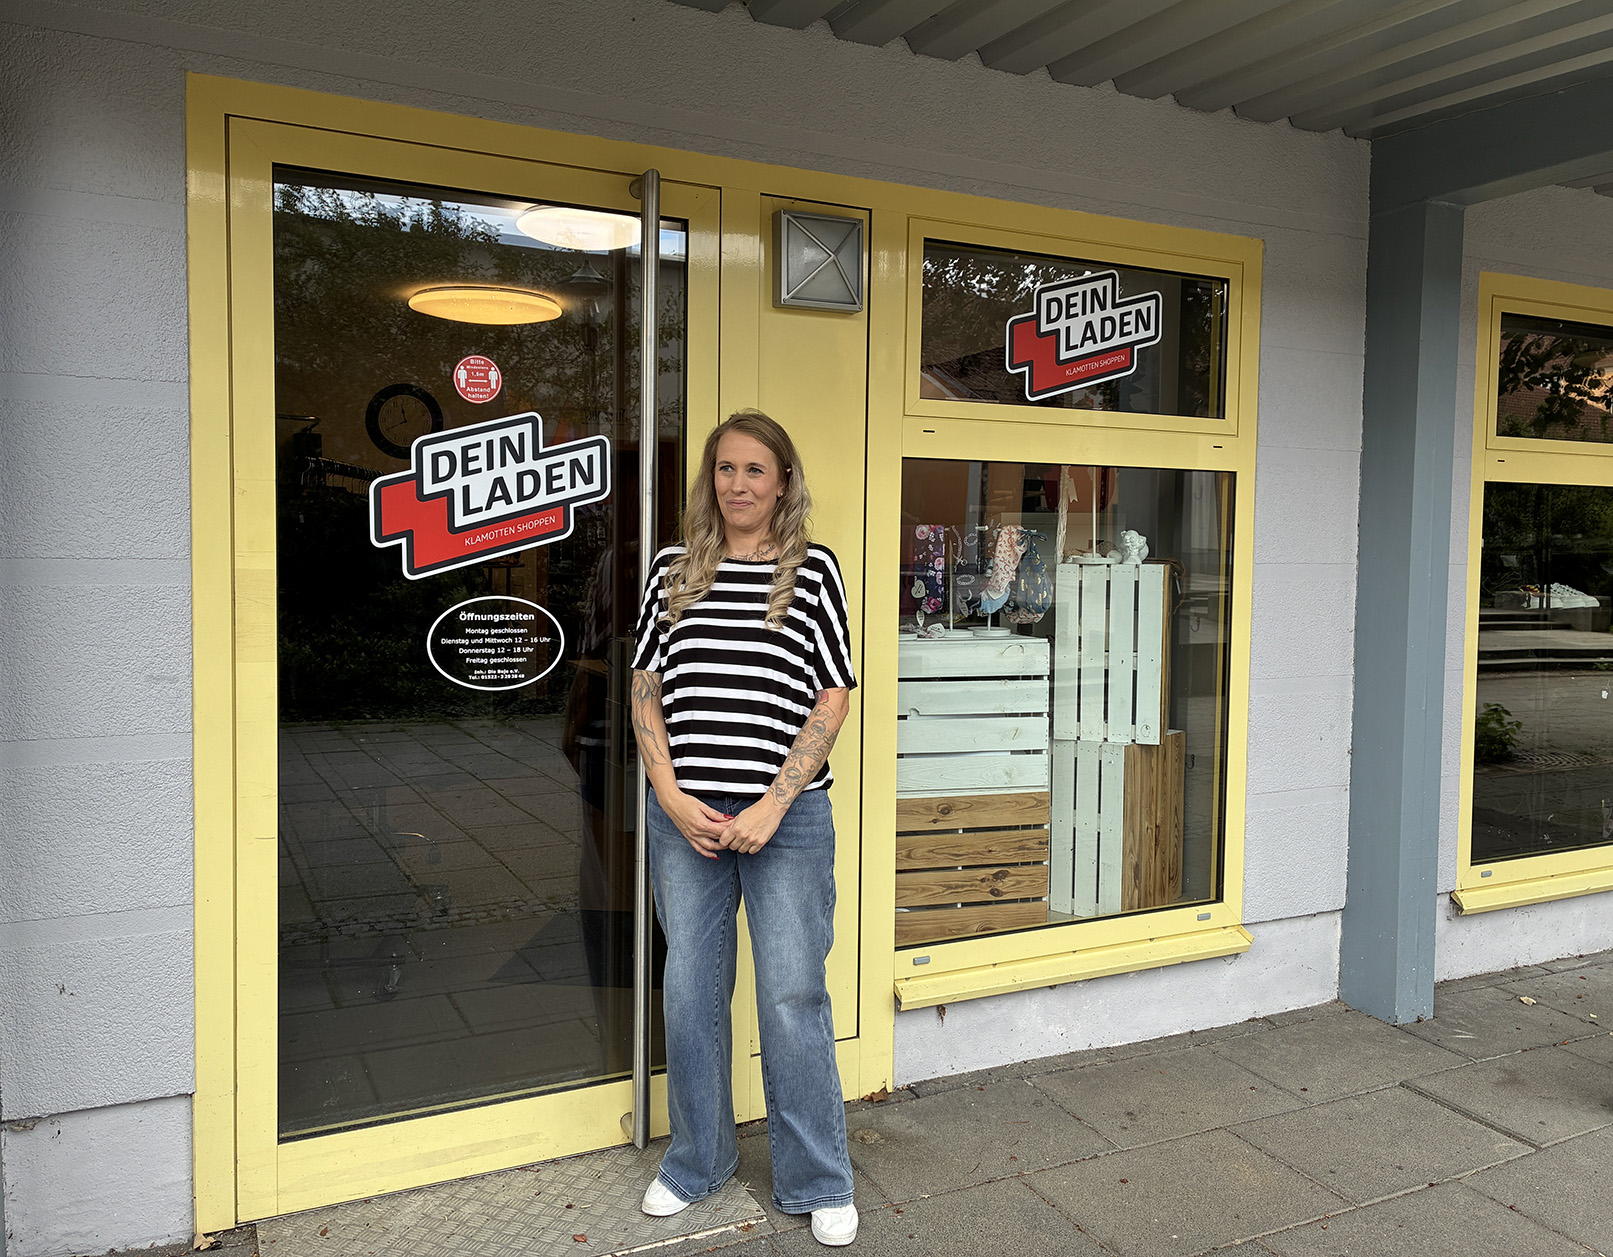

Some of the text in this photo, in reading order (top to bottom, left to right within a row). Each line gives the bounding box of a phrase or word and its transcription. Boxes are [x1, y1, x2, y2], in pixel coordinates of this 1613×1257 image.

[1046, 285, 1107, 325] DEIN
[1065, 306, 1152, 352] LADEN
[1065, 354, 1126, 376] KLAMOTTEN SHOPPEN
[431, 431, 525, 485] DEIN
[462, 454, 595, 517] LADEN
[464, 515, 556, 547] KLAMOTTEN SHOPPEN
[459, 611, 535, 623] Öffnungszeiten
[465, 627, 528, 635] Montag geschlossen
[466, 656, 527, 665] Freitag geschlossen
